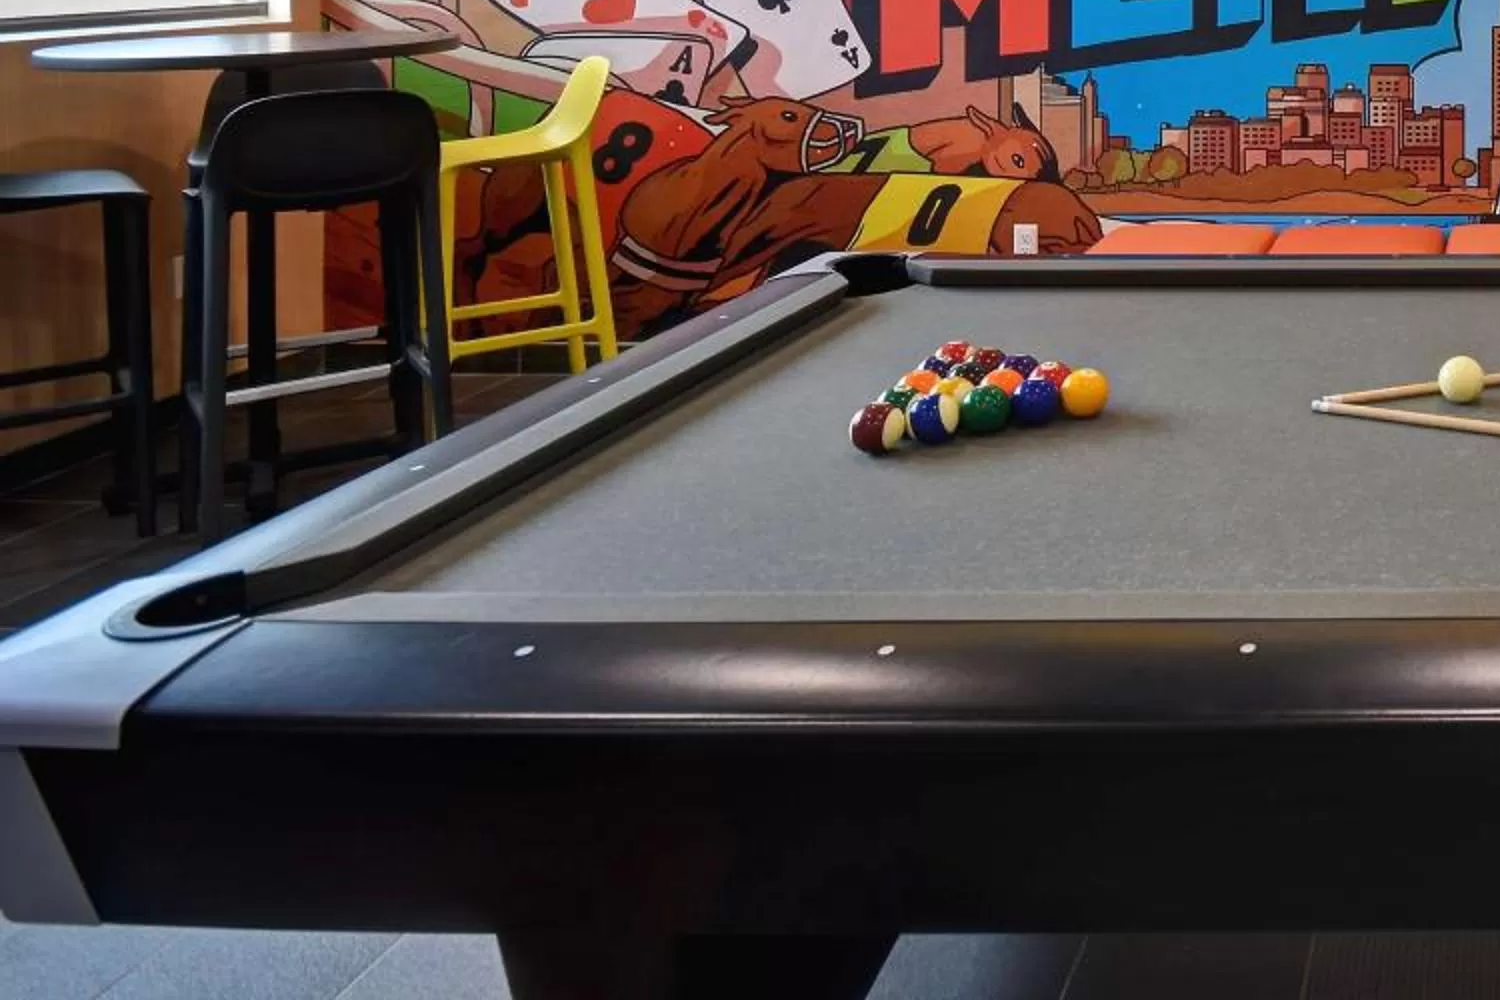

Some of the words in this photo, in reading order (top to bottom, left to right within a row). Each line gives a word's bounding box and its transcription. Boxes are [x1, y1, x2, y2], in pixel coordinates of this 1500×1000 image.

[669, 44, 694, 75] A
[592, 121, 654, 184] 8
[906, 183, 962, 246] 0
